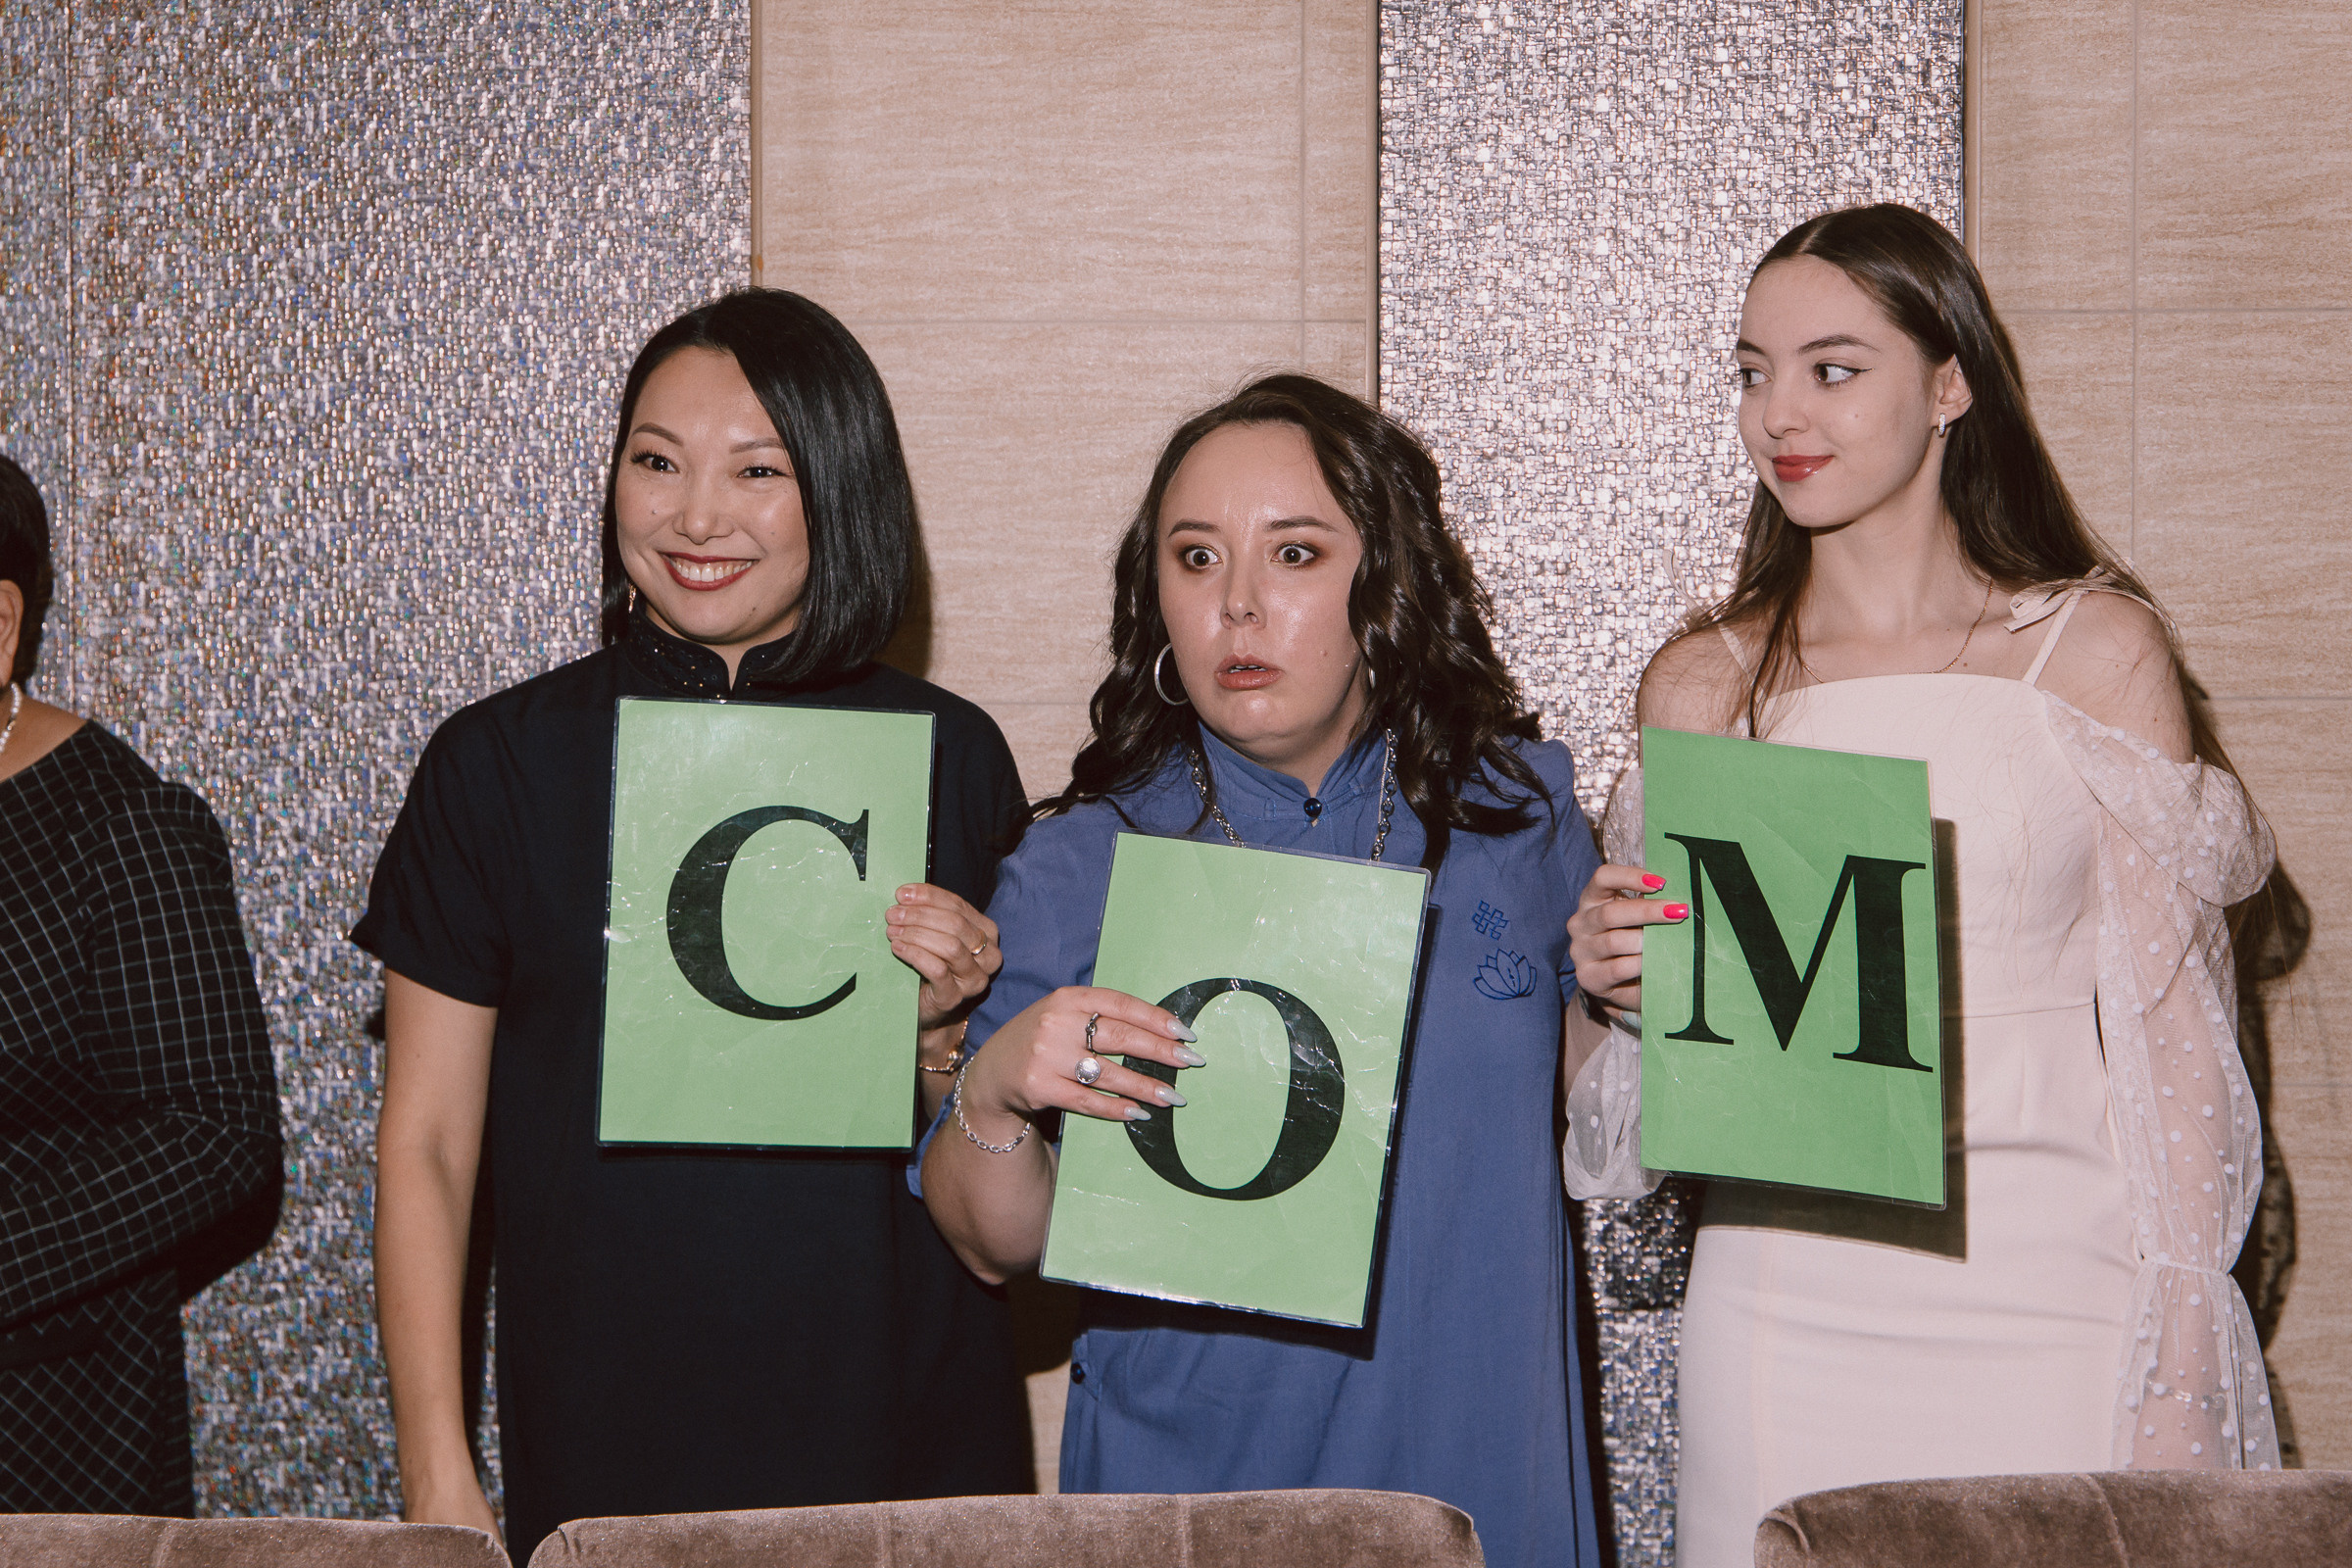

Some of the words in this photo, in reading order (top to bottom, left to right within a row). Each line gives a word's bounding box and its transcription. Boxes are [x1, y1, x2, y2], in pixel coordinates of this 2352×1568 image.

[666, 805, 869, 1021] C
[1664, 831, 1934, 1073] M
[1121, 977, 1346, 1201] O
